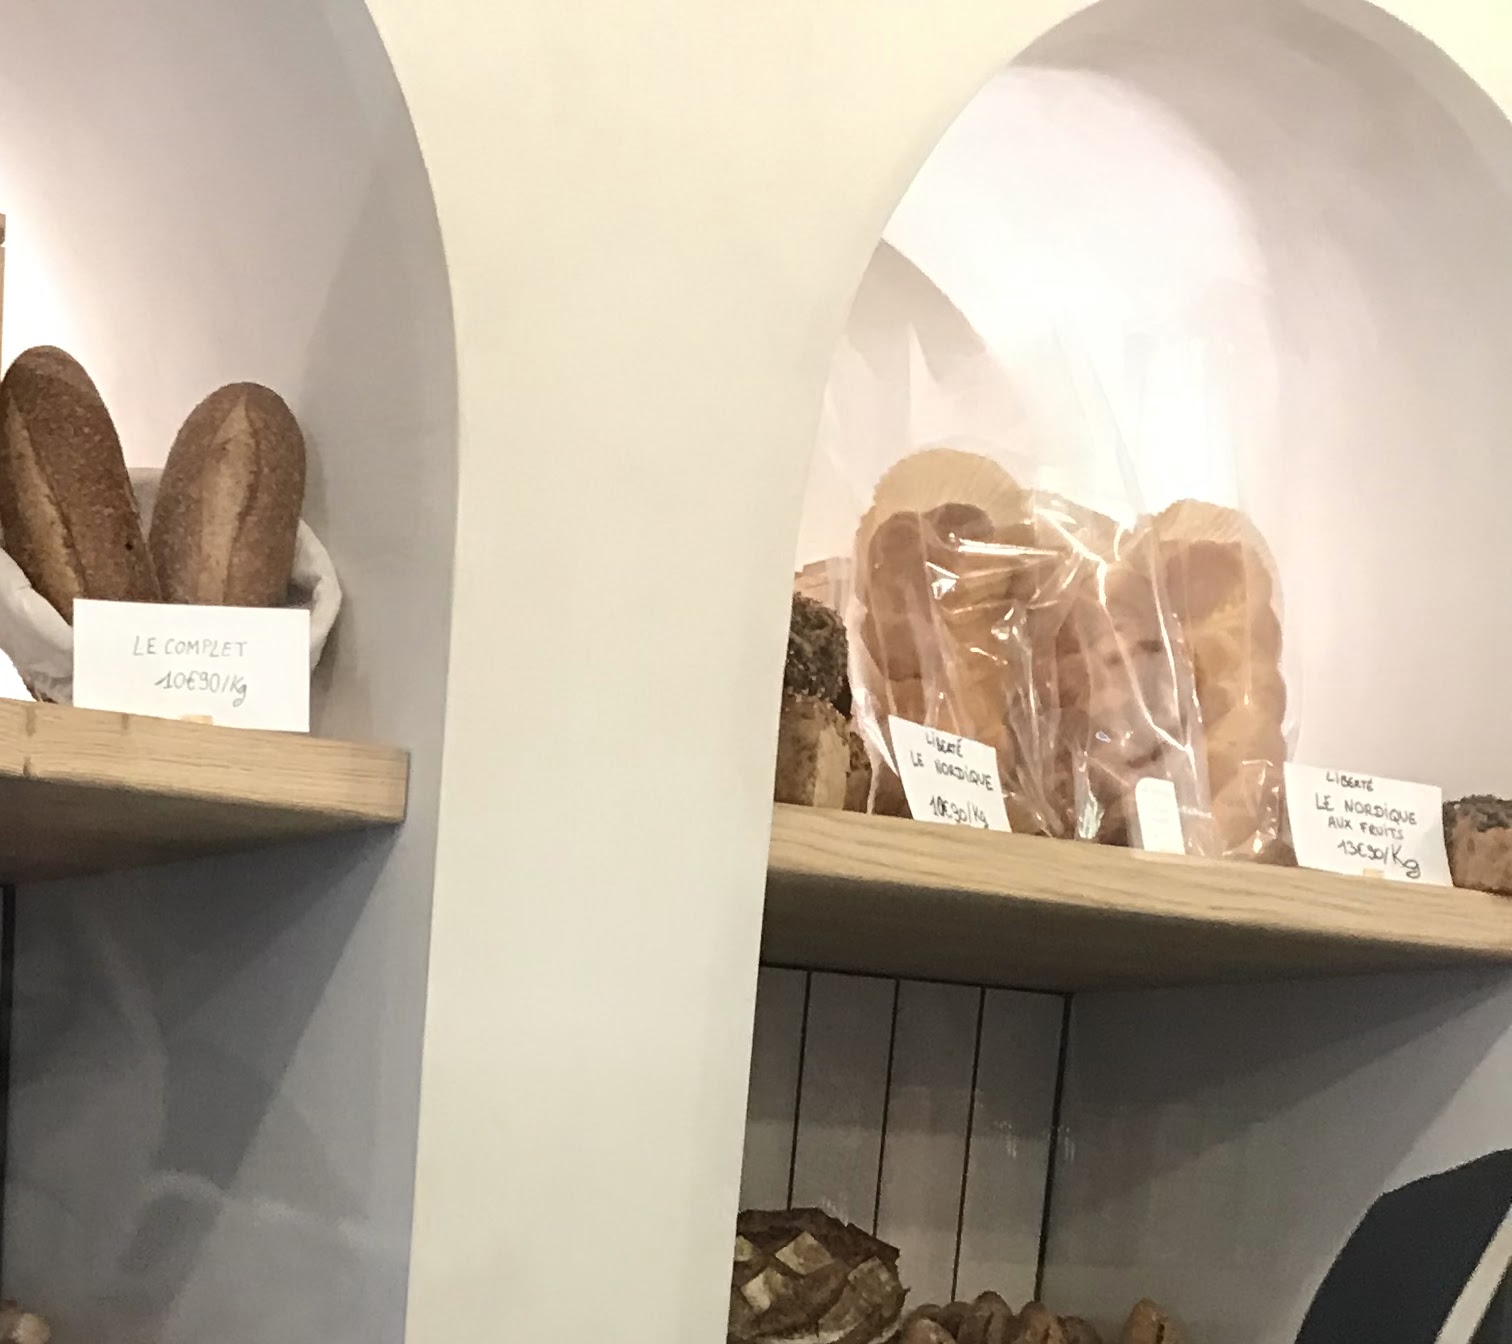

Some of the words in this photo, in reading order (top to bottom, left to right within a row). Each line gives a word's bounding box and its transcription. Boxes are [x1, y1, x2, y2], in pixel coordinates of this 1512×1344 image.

[131, 635, 157, 656] LE
[164, 638, 248, 657] COMPLET
[910, 750, 924, 767] LE
[1315, 792, 1334, 812] LE
[1328, 816, 1353, 830] AUX
[1359, 822, 1404, 840] FRUITS
